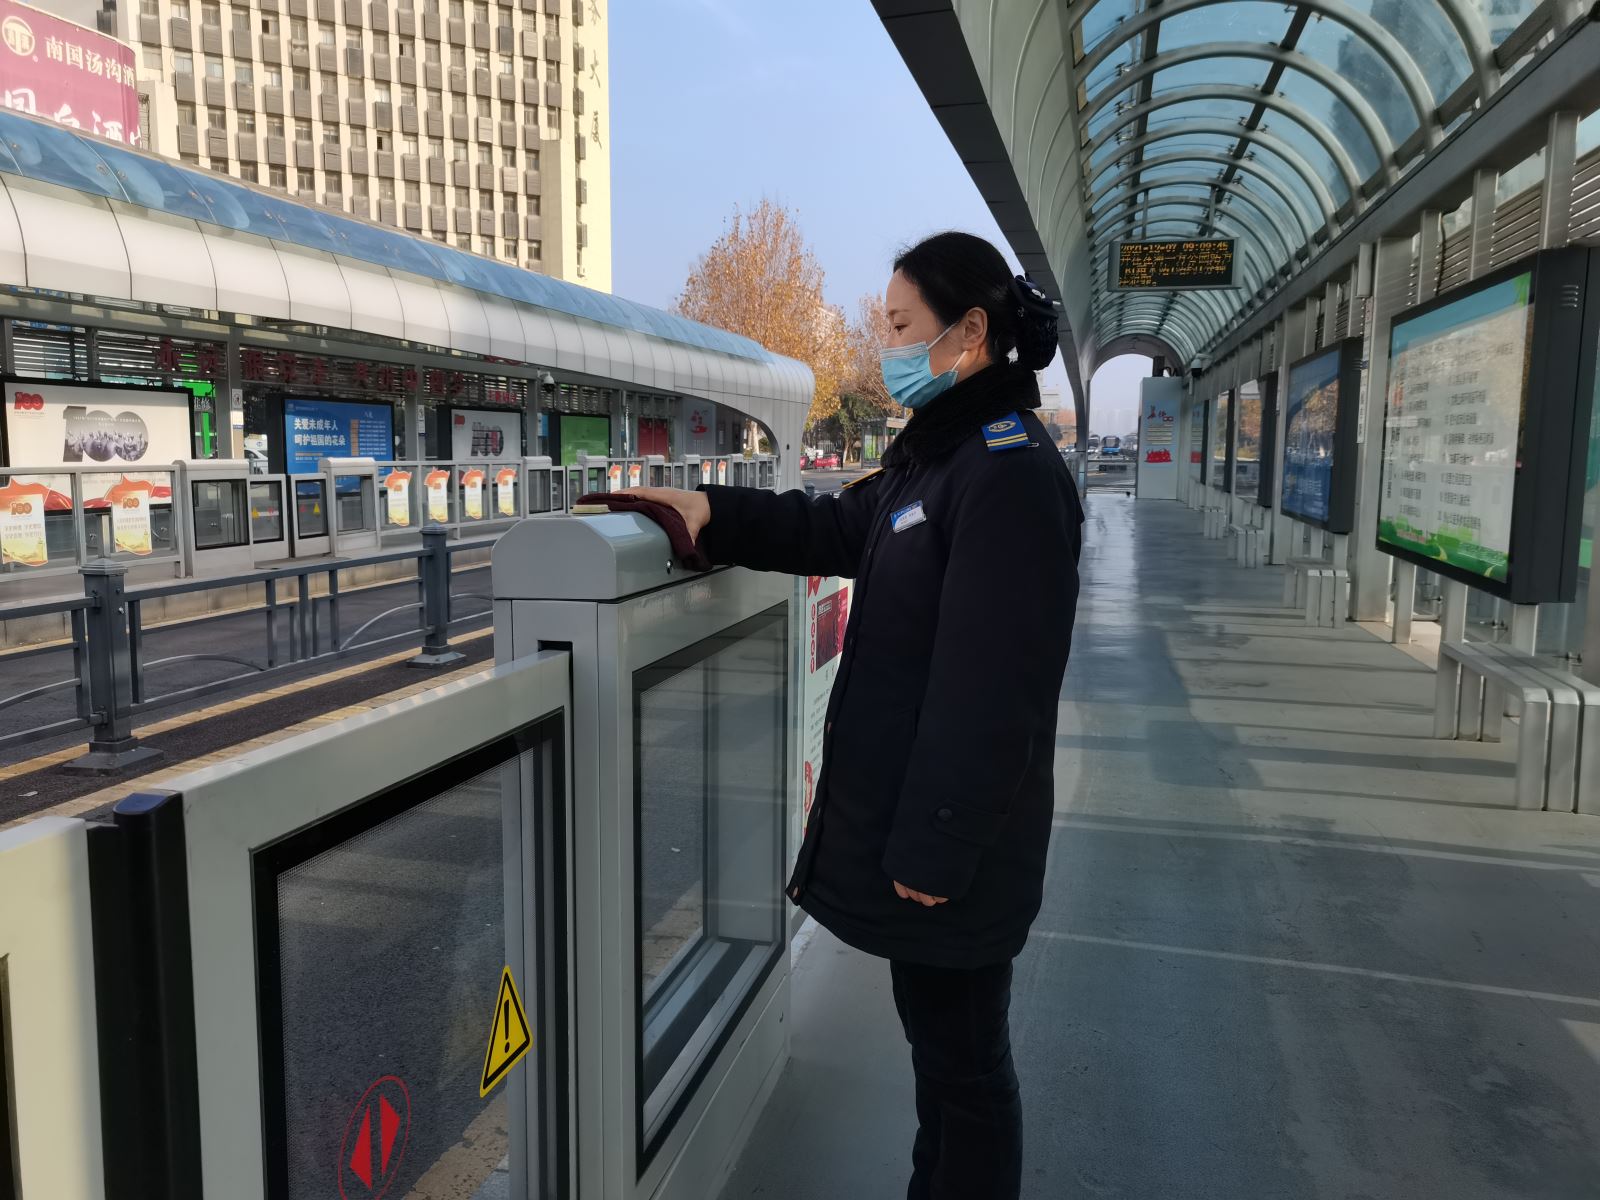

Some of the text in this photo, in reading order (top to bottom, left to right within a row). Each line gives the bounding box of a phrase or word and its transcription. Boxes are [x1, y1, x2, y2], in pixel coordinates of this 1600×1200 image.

[45, 35, 136, 90] 南国汤沟酒
[62, 405, 149, 463] 100
[293, 417, 339, 431] 关爱未成年人
[294, 433, 346, 446] 呵护祖国的花朵
